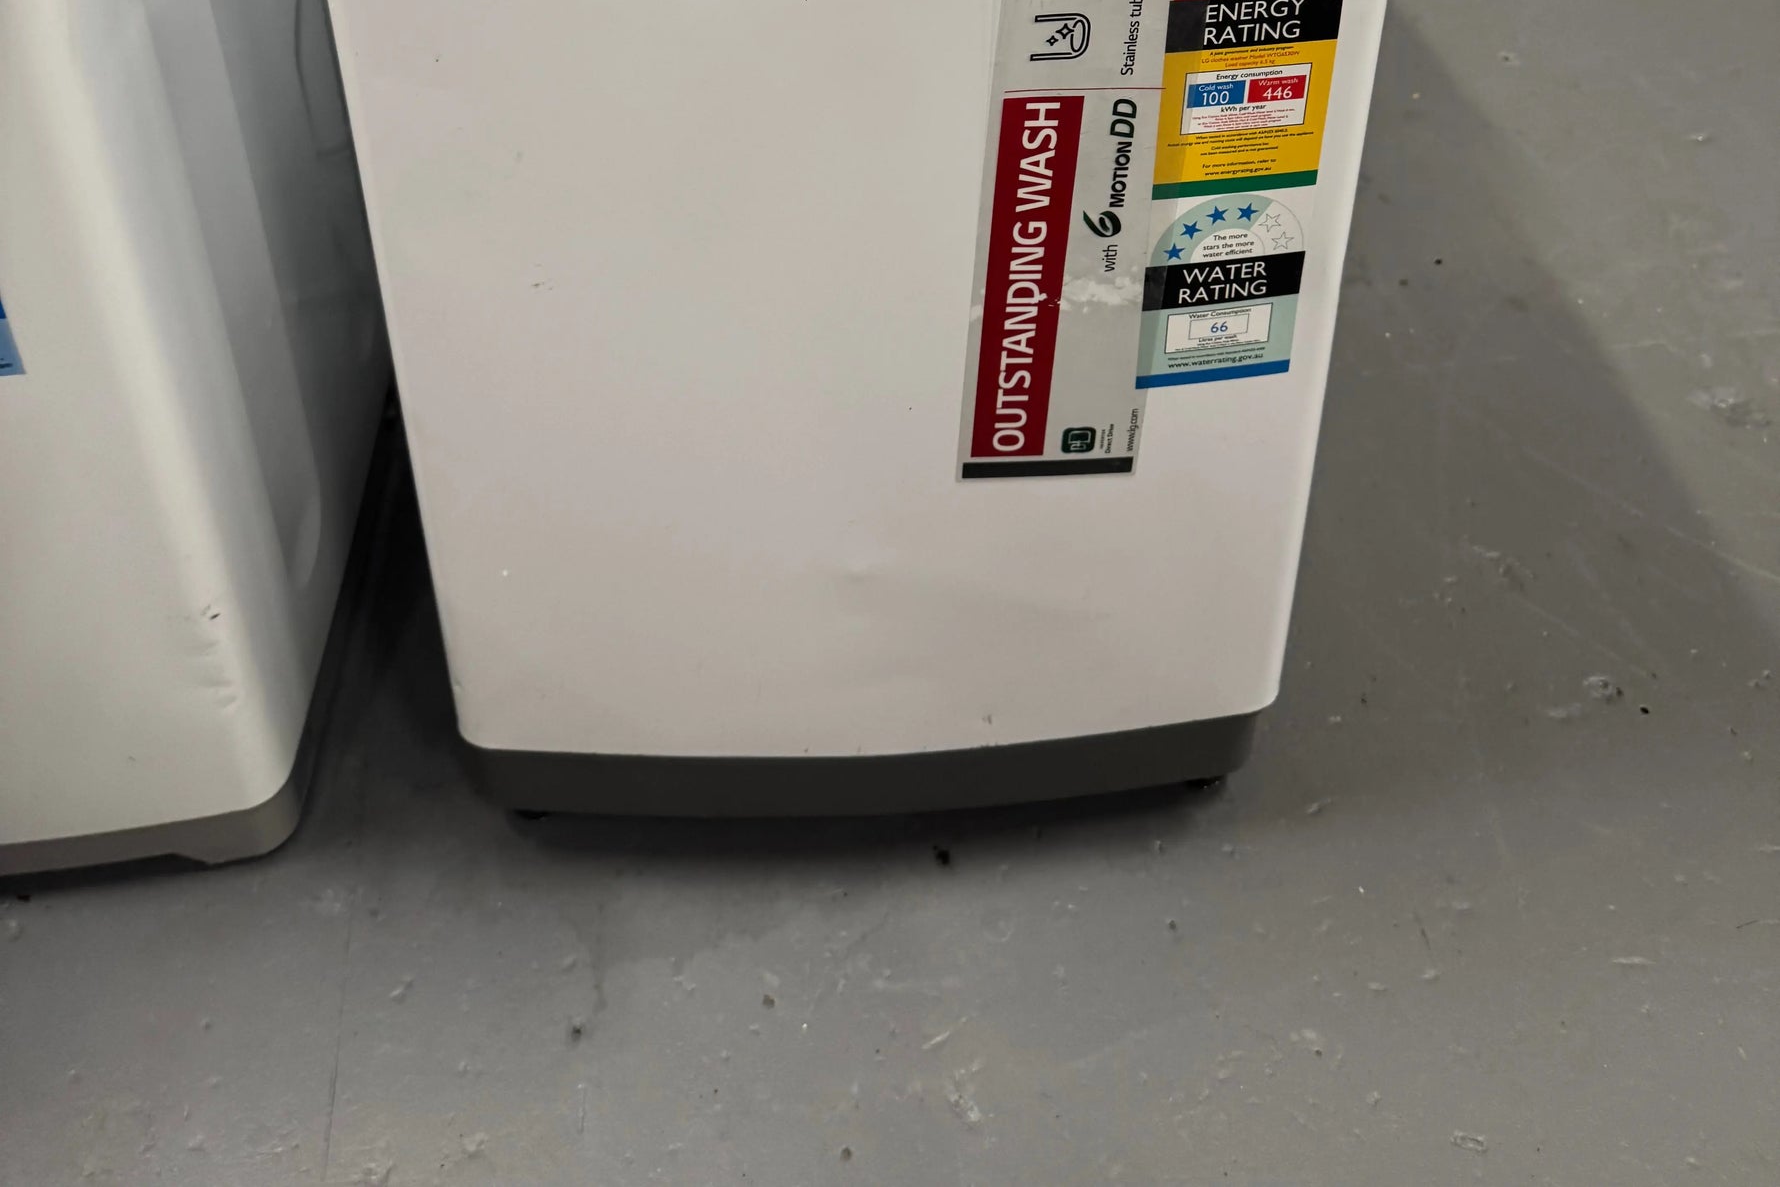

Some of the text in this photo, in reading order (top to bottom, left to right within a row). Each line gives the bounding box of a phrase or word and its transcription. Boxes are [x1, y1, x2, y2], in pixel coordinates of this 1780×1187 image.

[1203, 20, 1301, 46] RATING
[1120, 20, 1140, 76] Stainless
[1216, 70, 1283, 81] Energy consumption
[1199, 84, 1215, 92] Cold
[1263, 86, 1293, 100] 446
[1203, 91, 1229, 105] 100
[1110, 98, 1138, 139] DD
[1109, 141, 1133, 208] MOTION
[1205, 166, 1272, 176] www.energyrating.gov.au
[1102, 243, 1118, 272] with
[1225, 248, 1253, 256] efficient
[992, 102, 1061, 452] OUTSTANDING WASH
[1183, 261, 1267, 284] WATER
[1178, 279, 1268, 304] RATING
[1210, 321, 1228, 333] 66
[1168, 353, 1264, 369] www.waterrating.gov.au
